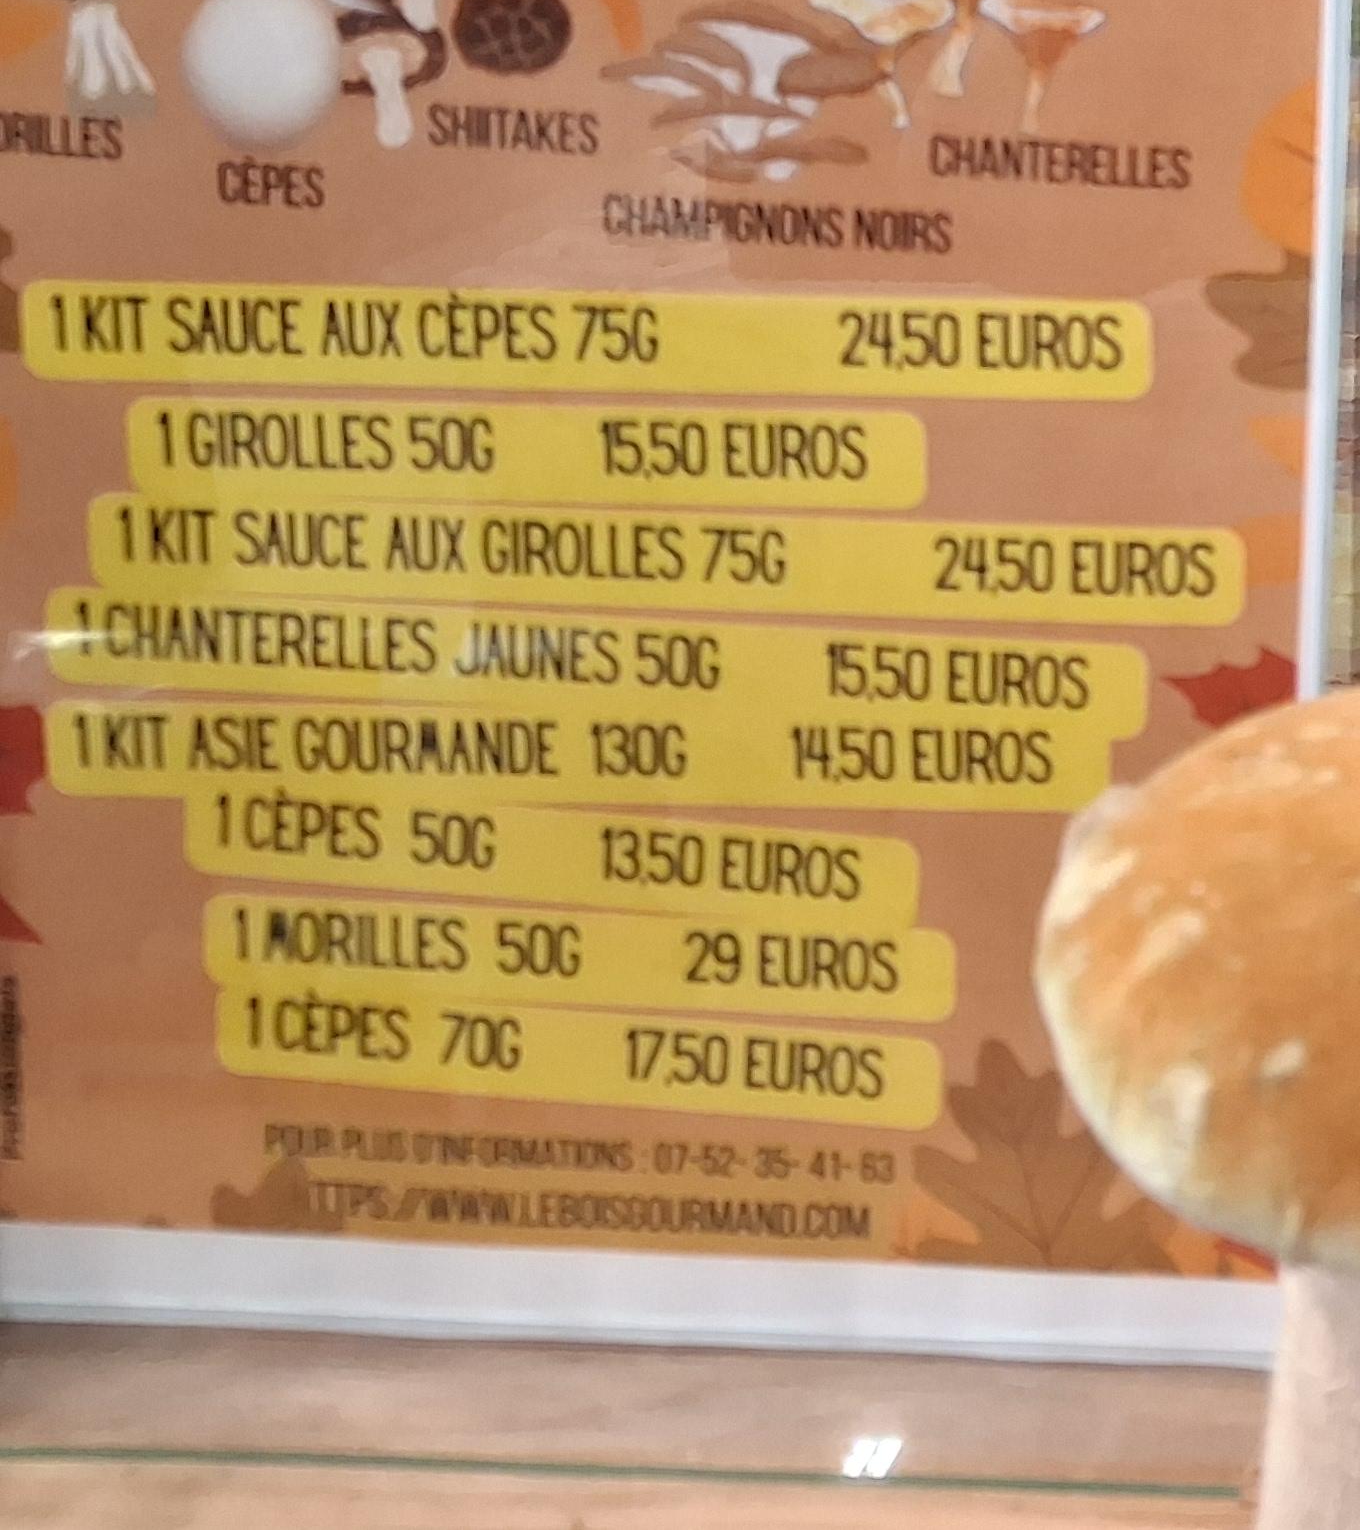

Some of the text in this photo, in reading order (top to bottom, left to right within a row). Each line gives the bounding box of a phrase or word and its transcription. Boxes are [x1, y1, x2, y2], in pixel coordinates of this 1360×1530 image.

[217, 155, 325, 207] CÈPES
[930, 134, 1192, 188] CHANTERELLES
[603, 194, 953, 254] CHAMPIGNONS NOIRS
[50, 294, 67, 351] 1
[82, 295, 148, 352] KIT
[167, 297, 302, 355] SAUCE
[322, 301, 401, 357] AUX
[418, 292, 557, 360] CÈPES
[573, 305, 658, 362] 75G
[976, 312, 1122, 371] EUROS
[158, 412, 173, 466] 1
[186, 411, 393, 470] GIROLLES
[408, 415, 494, 473] 50G
[723, 422, 867, 480] EUROS
[119, 506, 134, 562] 1
[149, 508, 215, 563] KIT
[234, 510, 367, 569] SAUCE
[386, 516, 464, 571] AUX
[482, 519, 685, 580] GIROLLES
[701, 527, 786, 584] 75G
[1071, 540, 1215, 597] EUROS
[76, 601, 92, 657] 1
[102, 602, 436, 673] CHANTERELLES
[455, 623, 620, 684] JAUNES
[636, 632, 720, 690] 50G
[947, 649, 1088, 710] EUROS
[73, 714, 90, 767] 1
[103, 715, 167, 768] KIT
[189, 716, 279, 771] ASIE
[293, 718, 558, 775] GOURMANDE
[590, 723, 687, 777] 130G
[912, 728, 1052, 784] EUROS
[216, 793, 231, 846] 1
[243, 789, 380, 860] CÈPES
[410, 810, 495, 870] 50G
[720, 836, 860, 901] EUROS
[235, 908, 898, 993] 1 MORILLES 50G 29 EUROS
[247, 996, 262, 1047] 1
[273, 990, 409, 1060] CÈPES
[442, 1012, 521, 1071] 70G
[744, 1036, 883, 1098] EUROS
